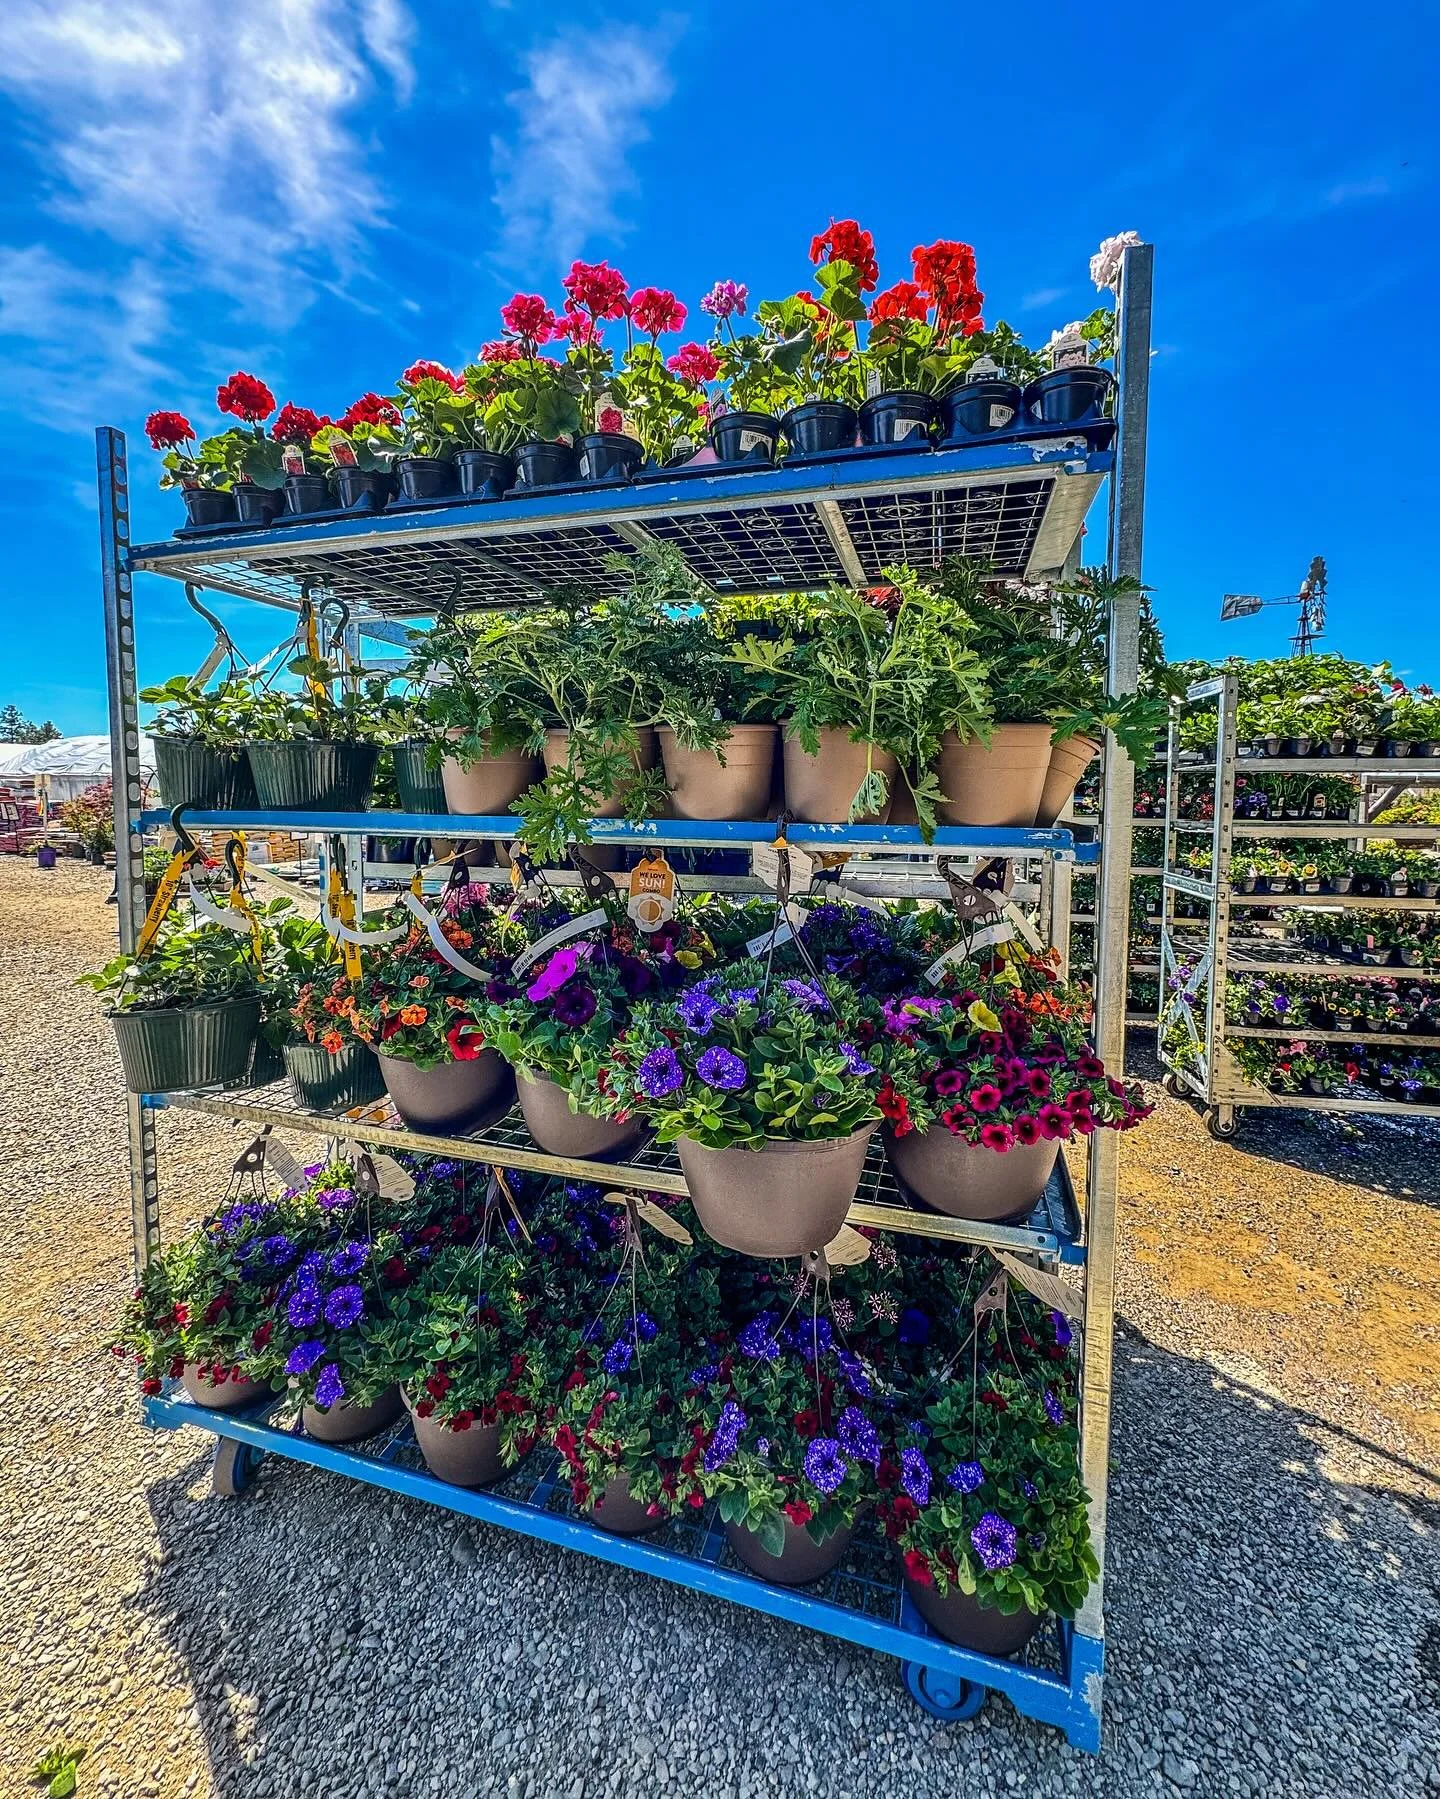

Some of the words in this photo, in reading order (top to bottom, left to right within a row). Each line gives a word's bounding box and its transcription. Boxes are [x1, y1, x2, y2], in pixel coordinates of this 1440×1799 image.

[165, 880, 175, 891] 10"
[639, 878, 665, 889] SUN!
[150, 891, 171, 924] Strawberry
